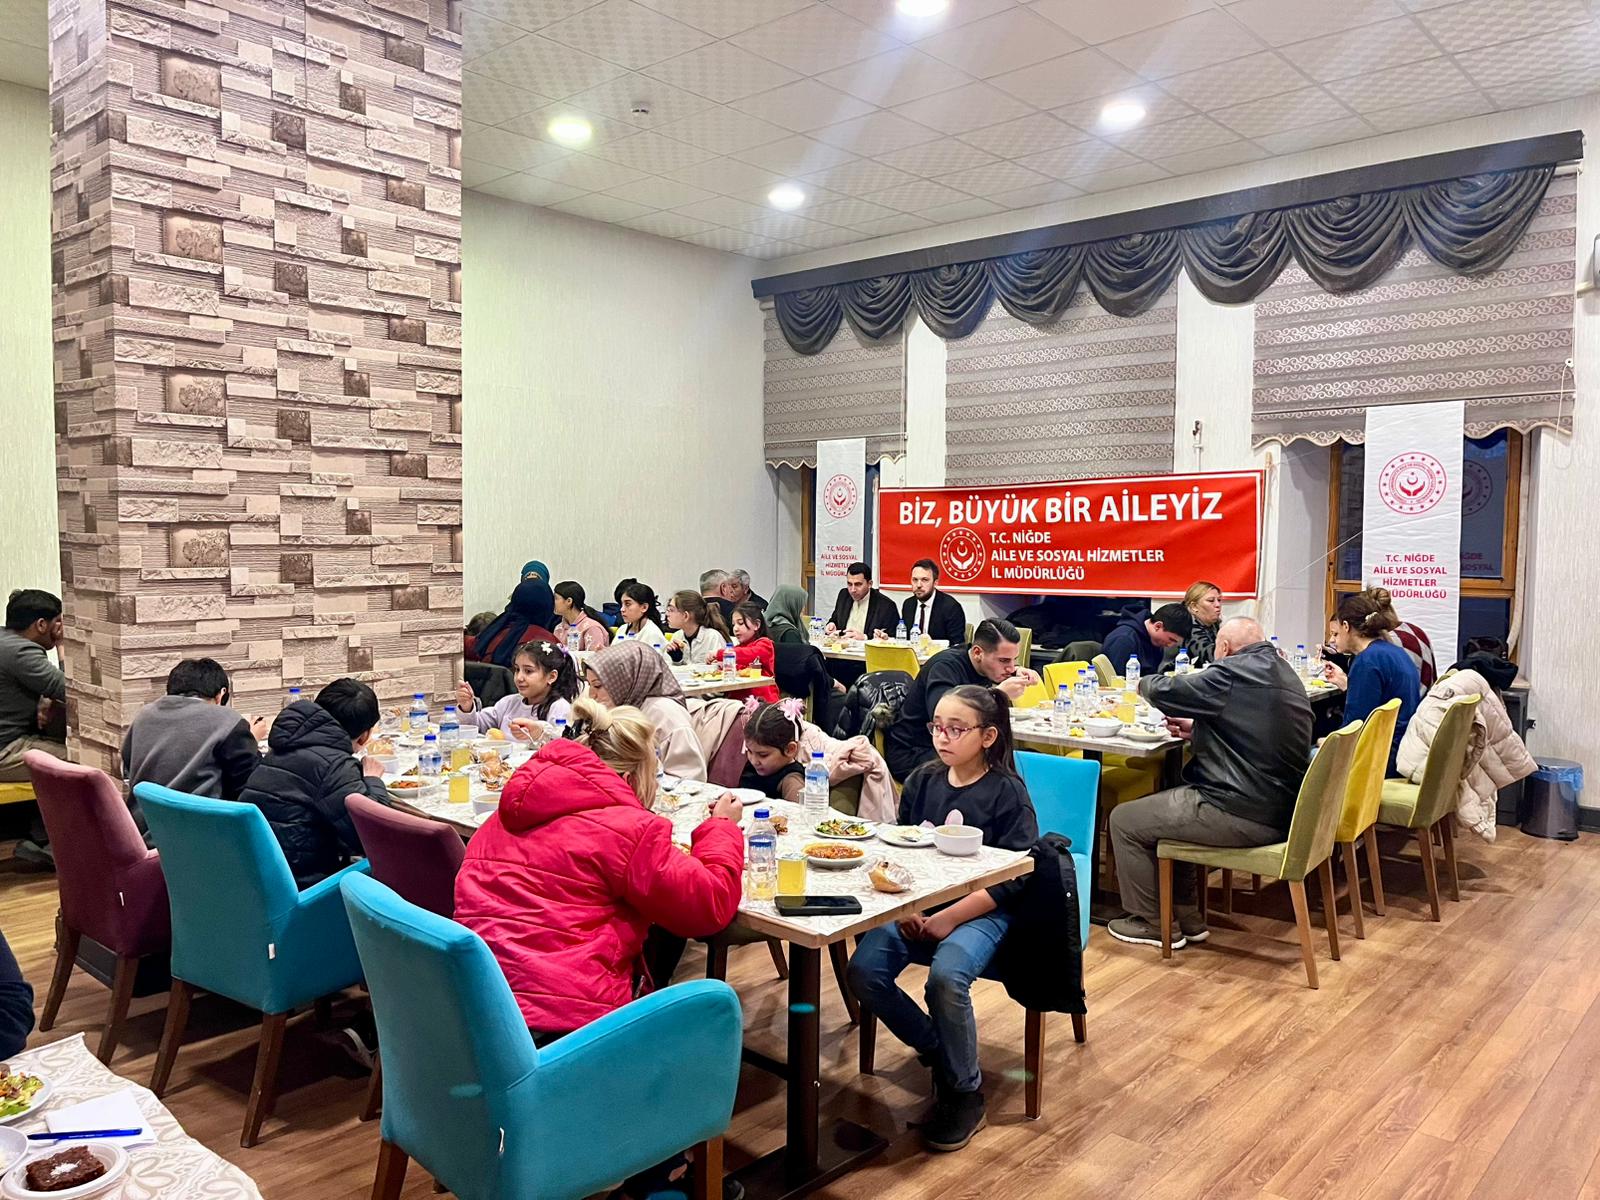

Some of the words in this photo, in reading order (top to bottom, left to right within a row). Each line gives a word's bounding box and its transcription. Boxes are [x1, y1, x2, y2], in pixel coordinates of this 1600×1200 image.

[899, 496, 942, 528] BİZ,
[948, 494, 1039, 524] BÜYÜK
[1045, 491, 1092, 523] BİR
[1099, 486, 1223, 522] AİLEYİZ
[989, 532, 1010, 543] T.C.
[1013, 530, 1051, 543] NİĞDE
[991, 547, 1017, 561] AİLE
[1018, 549, 1035, 562] VE
[1036, 549, 1084, 562] SOSYAL
[1087, 547, 1165, 562] HİZMETLER
[1385, 554, 1402, 562] T.C.
[1404, 553, 1435, 562] NİĞDE
[991, 564, 1002, 578] İL
[1003, 565, 1085, 580] MÜDÜRLÜĞÜ
[1373, 565, 1394, 574] AİLE
[1395, 566, 1408, 574] VE
[1410, 566, 1448, 575] SOSYAL
[1382, 575, 1437, 587] HİZMETLER
[1390, 589, 1447, 599] ÜDÜRLÜĞÜ
